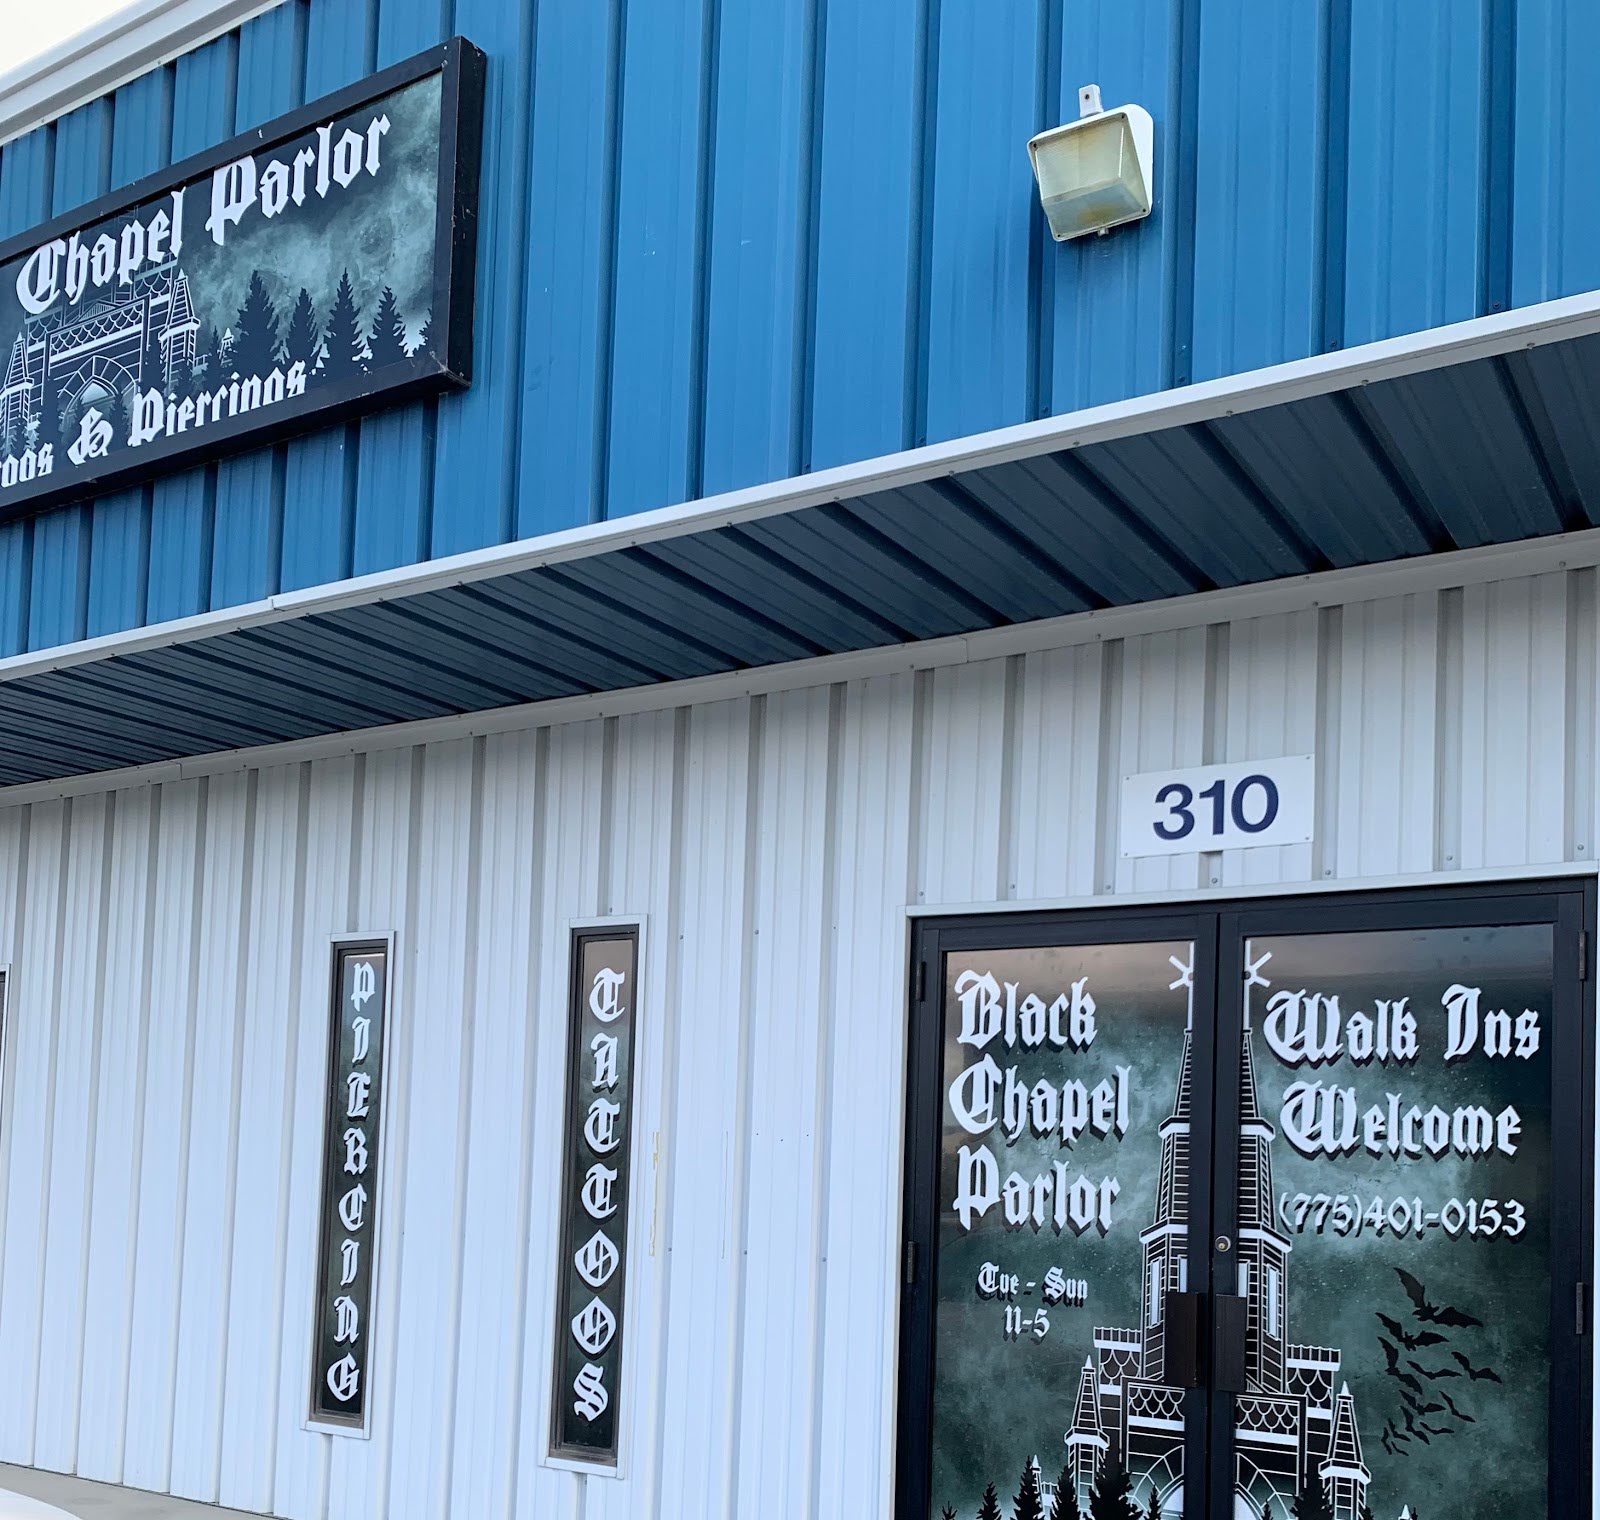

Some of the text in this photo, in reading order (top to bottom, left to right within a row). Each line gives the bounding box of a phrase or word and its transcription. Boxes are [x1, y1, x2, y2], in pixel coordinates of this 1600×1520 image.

[16, 113, 391, 314] Chapel Parlor
[67, 406, 114, 466] &
[1153, 774, 1279, 840] 310
[953, 969, 1098, 1049] Black
[1263, 983, 1541, 1063] Walk Ins
[948, 1053, 1132, 1143] Chapel
[1279, 1080, 1522, 1156] Welcome
[326, 961, 375, 1402] PIERCING
[570, 966, 626, 1422] TATTOOS
[952, 1144, 1121, 1231] Parlor
[1278, 1191, 1527, 1237] (775)401-0153
[977, 1261, 1018, 1295] Tue
[1044, 1266, 1088, 1301] Sun
[1003, 1305, 1050, 1339] 11-5
